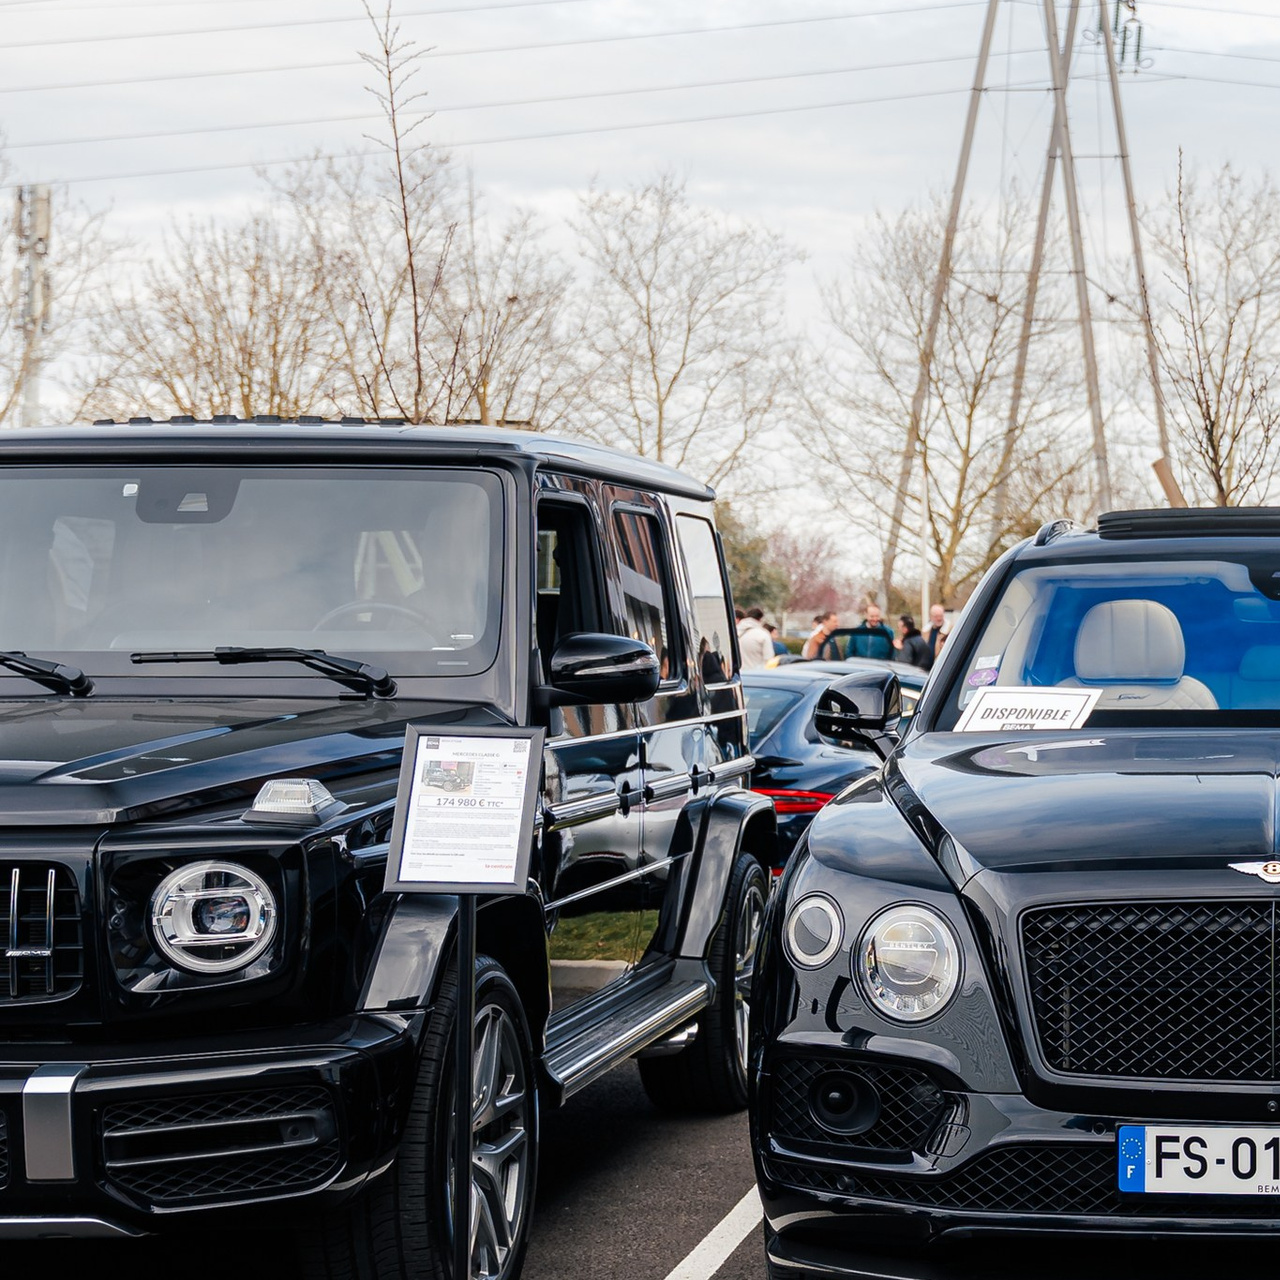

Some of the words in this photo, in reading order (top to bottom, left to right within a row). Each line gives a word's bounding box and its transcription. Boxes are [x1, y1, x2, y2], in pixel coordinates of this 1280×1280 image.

[980, 707, 1071, 721] DISPONIBLE
[1002, 723, 1031, 731] BEMA
[436, 797, 455, 807] 174
[457, 798, 477, 808] 980
[478, 799, 485, 808] €
[1126, 1165, 1136, 1179] F
